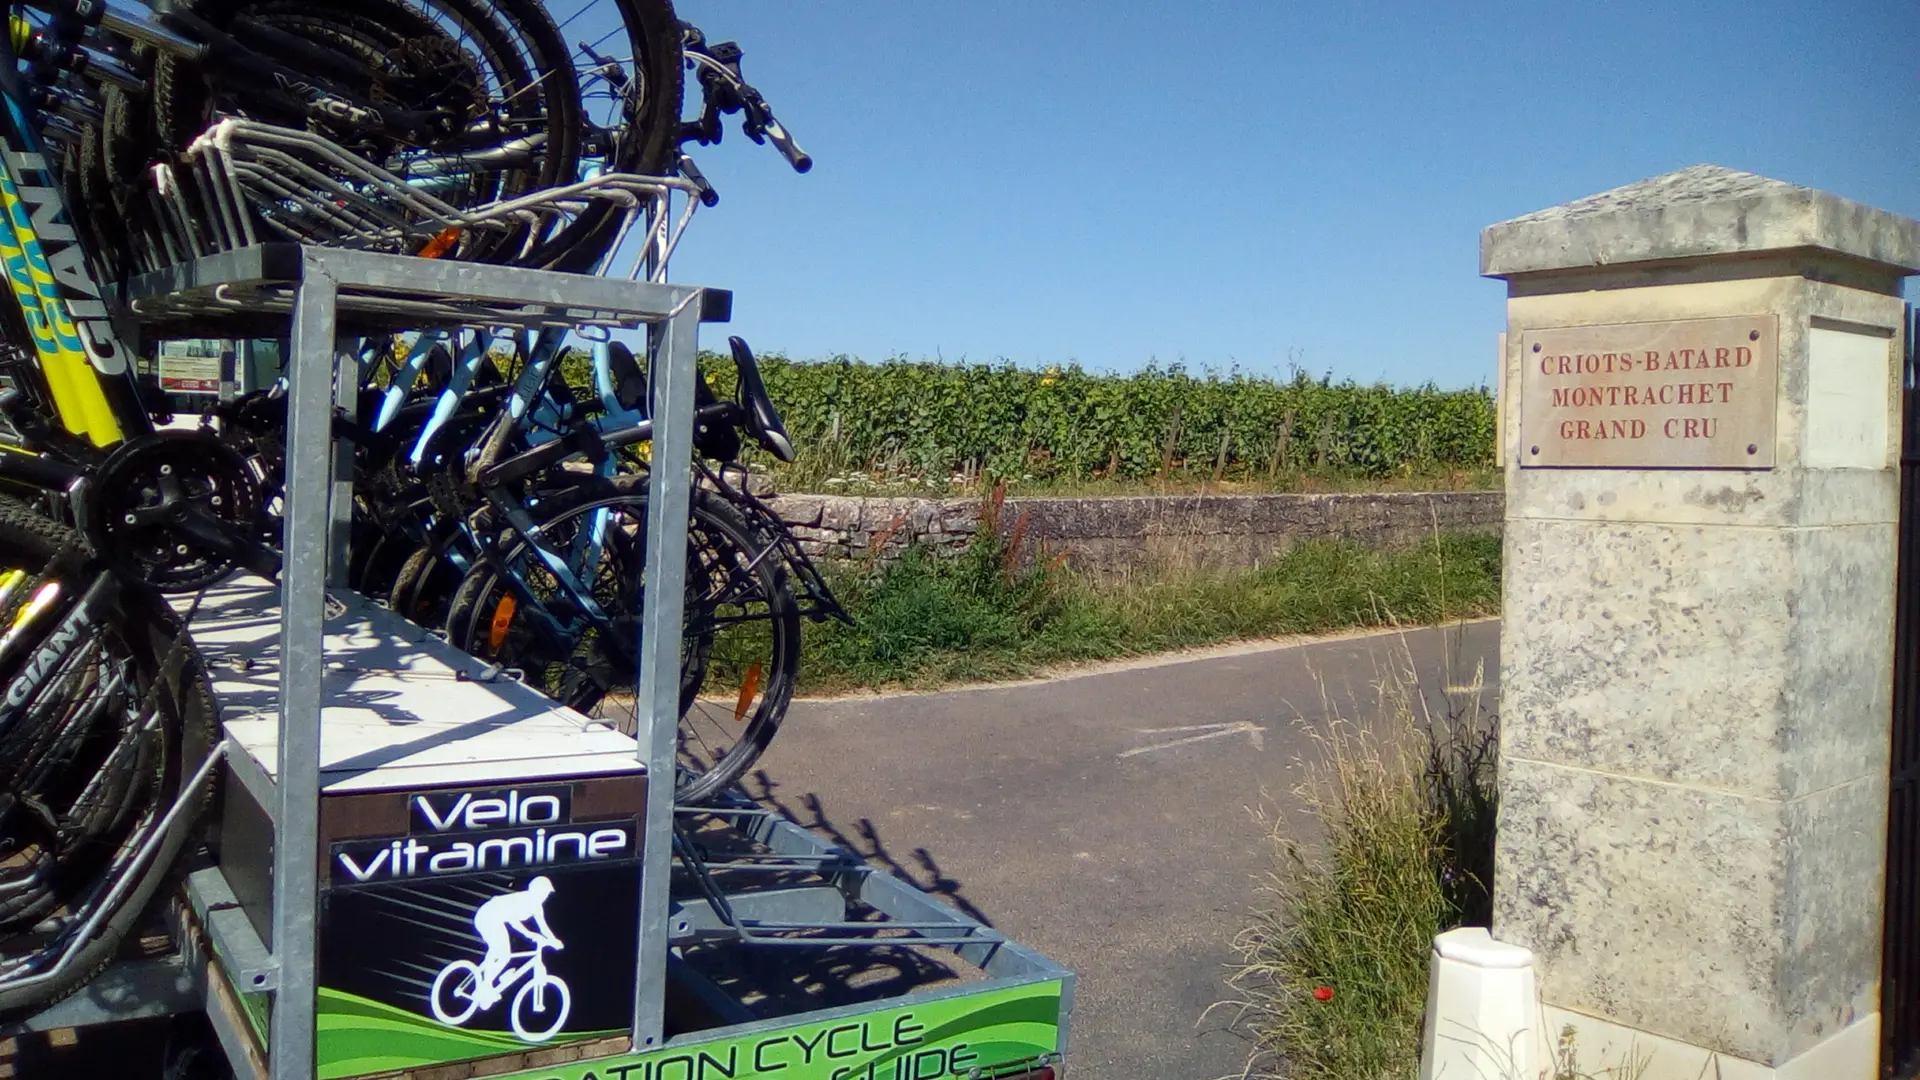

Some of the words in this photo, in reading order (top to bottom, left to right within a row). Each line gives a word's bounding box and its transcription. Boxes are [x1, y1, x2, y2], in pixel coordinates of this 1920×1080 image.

[0, 136, 128, 375] GIANT
[1540, 346, 1752, 376] CRIOTS-BATARD
[1552, 382, 1734, 408] MONTRACHET
[1560, 419, 1646, 440] GRAND
[1663, 417, 1718, 439] CRU
[7, 600, 90, 707] GIANT
[416, 790, 560, 831] Velo
[338, 828, 627, 882] vitamine
[754, 1014, 924, 1072] CYCLE
